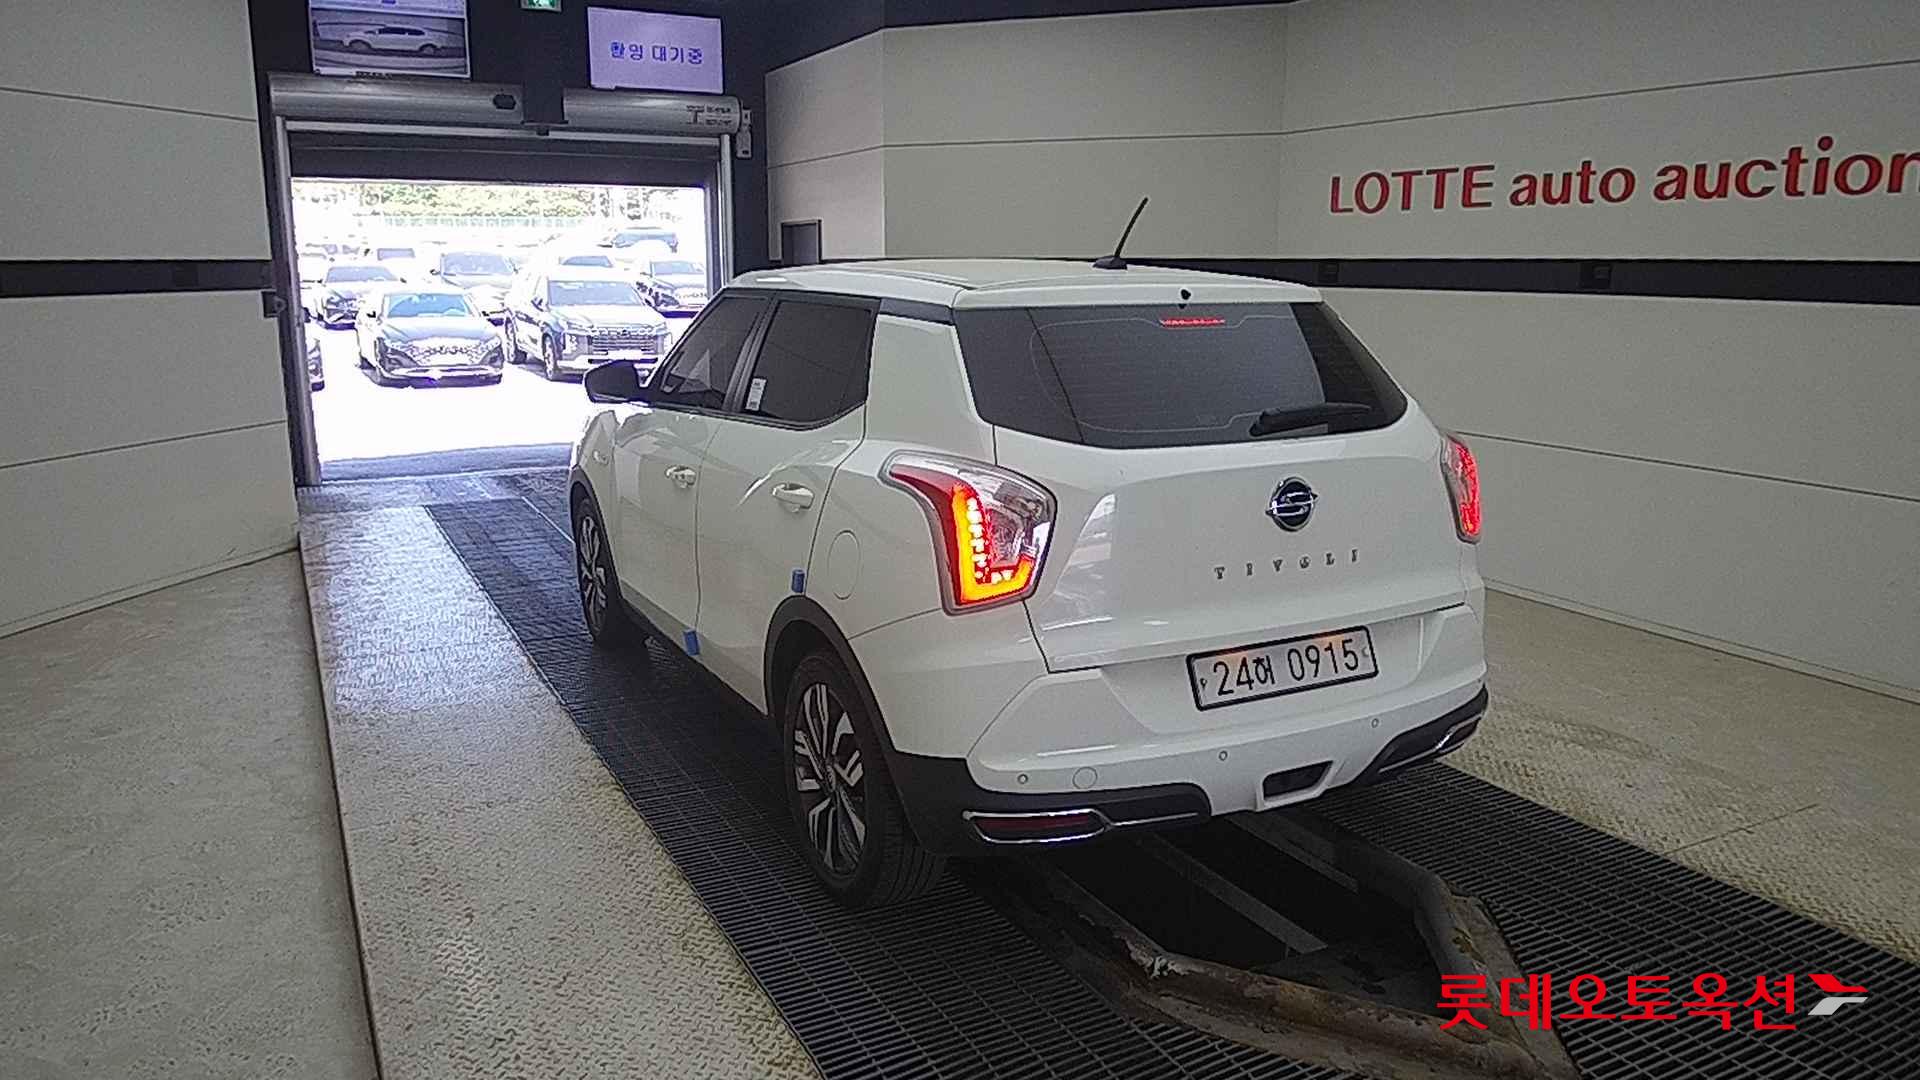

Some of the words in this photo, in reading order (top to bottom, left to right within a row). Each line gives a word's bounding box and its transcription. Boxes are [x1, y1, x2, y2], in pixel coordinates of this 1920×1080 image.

[652, 45, 702, 65] 대기중
[1330, 165, 1495, 214] LOTTE
[1509, 160, 1636, 207] auto
[1214, 549, 1358, 580] TIVOLI
[1213, 655, 1276, 697] 24허
[1287, 638, 1359, 682] 0915
